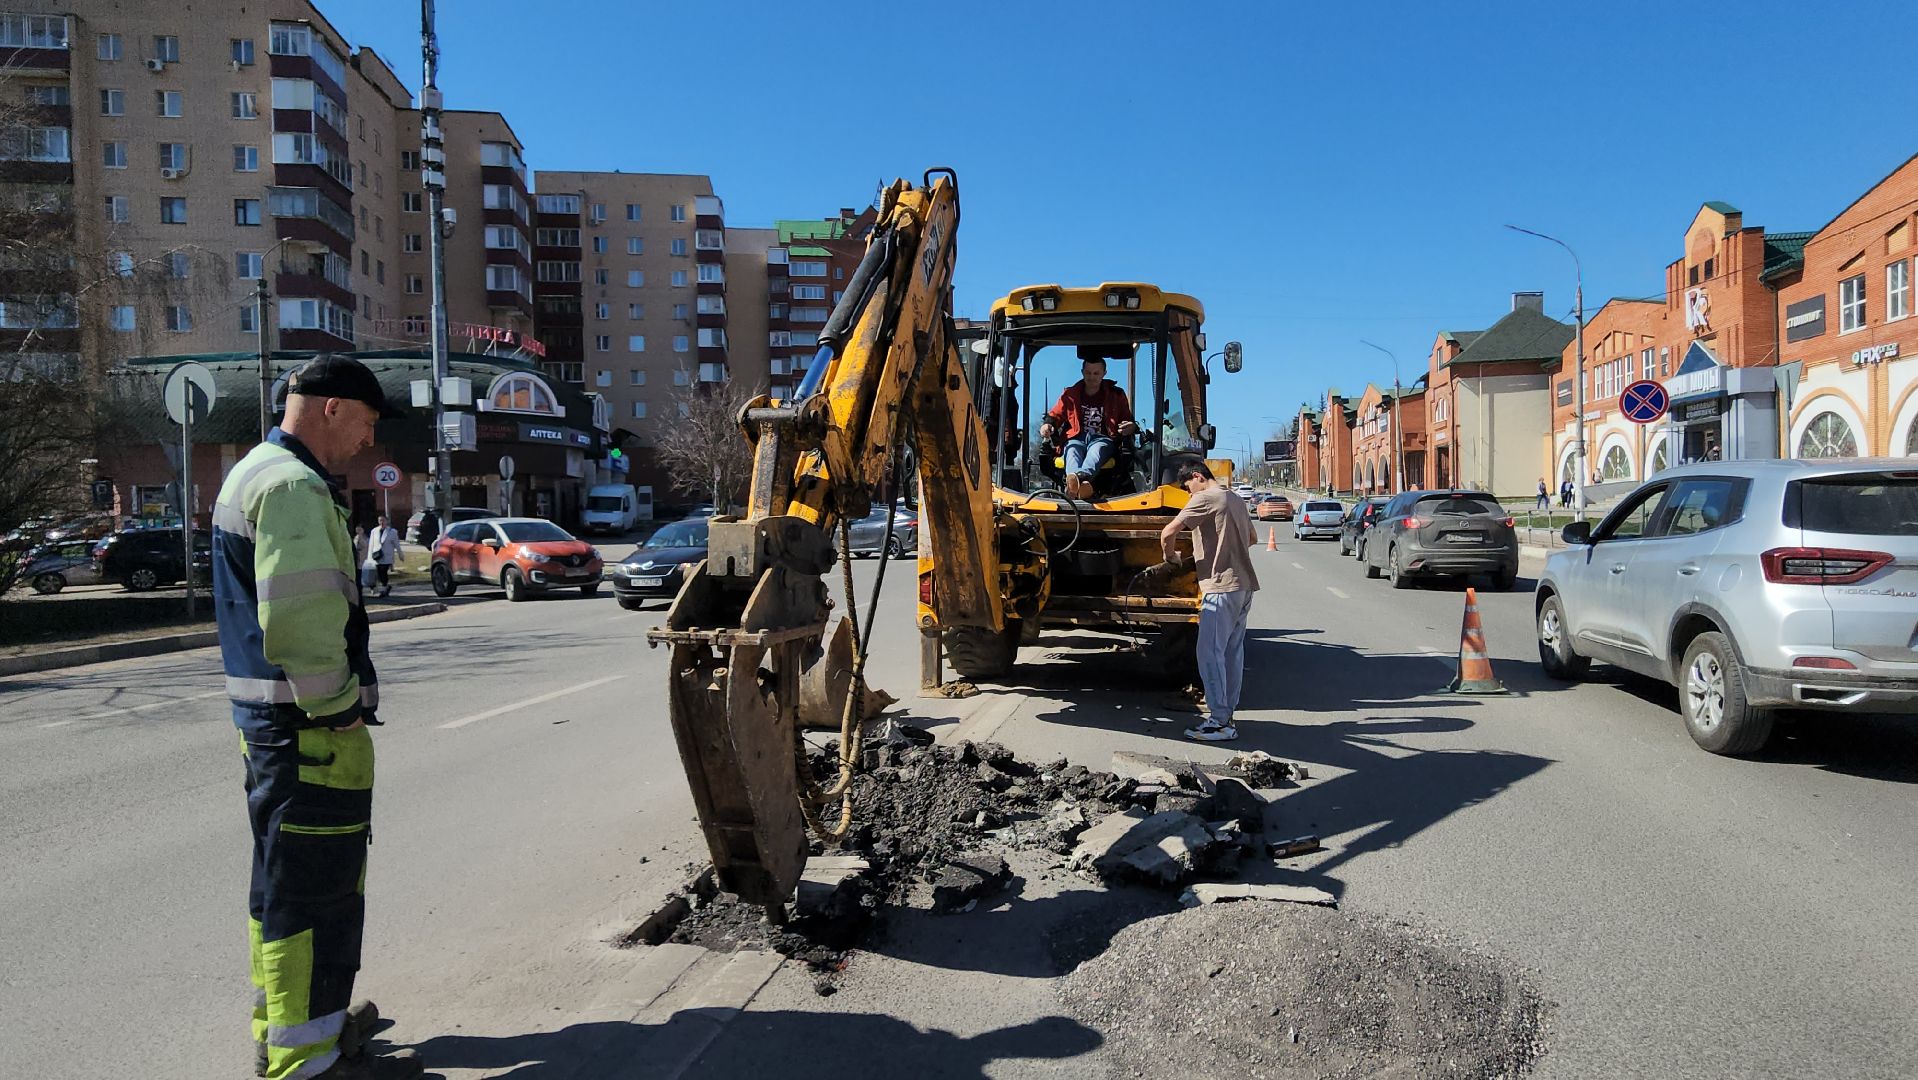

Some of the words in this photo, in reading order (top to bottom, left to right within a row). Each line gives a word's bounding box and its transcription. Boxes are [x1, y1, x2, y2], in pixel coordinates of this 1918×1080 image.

[1861, 345, 1881, 363] FIX
[1690, 368, 1719, 392] МОДЫ
[530, 429, 562, 439] АПТЕКА
[380, 470, 396, 482] 20
[471, 476, 487, 486] 24
[1837, 588, 1881, 596] TIGGO
